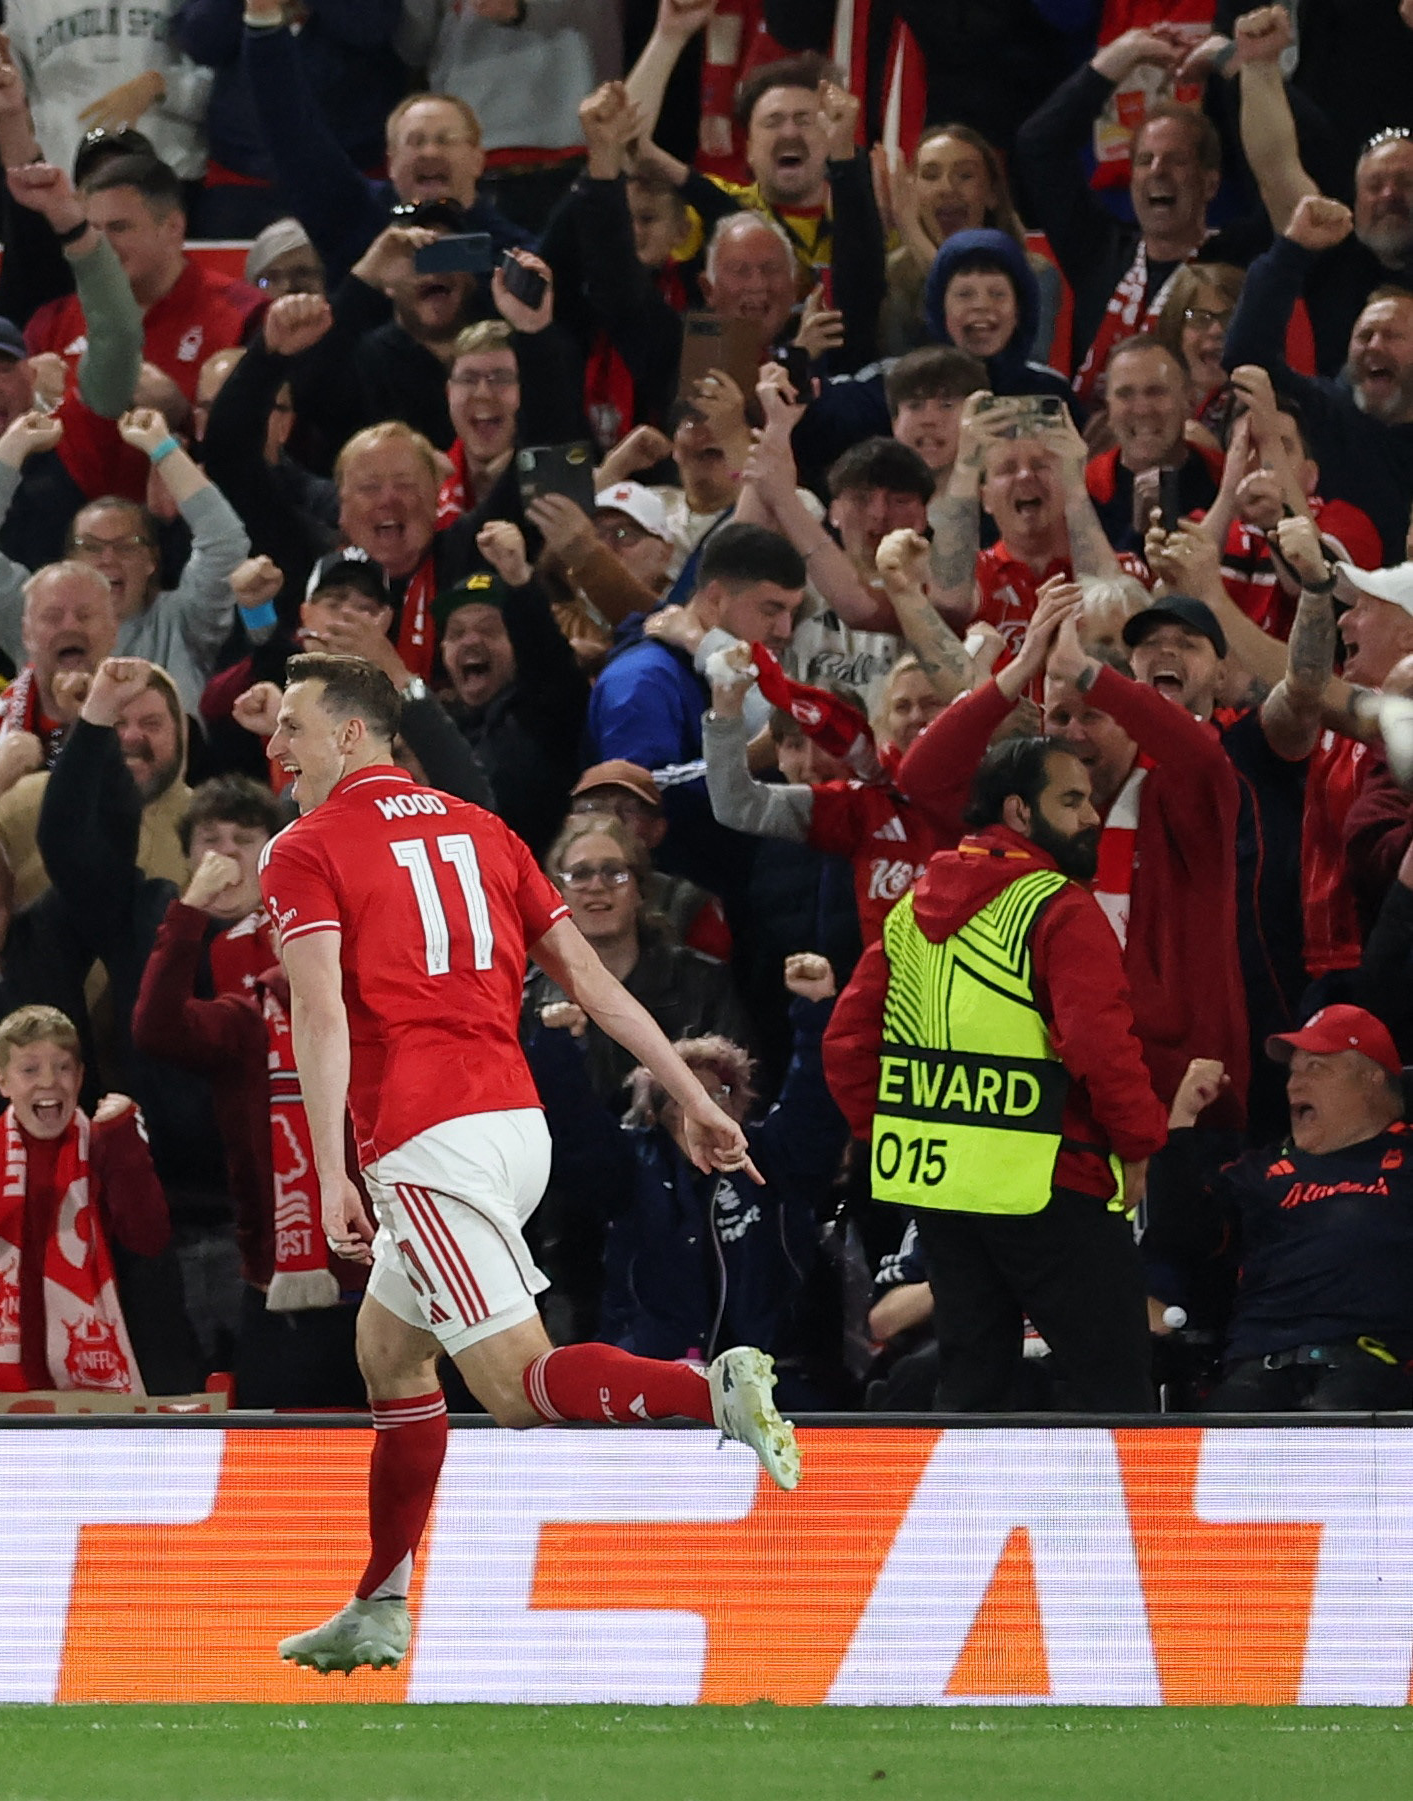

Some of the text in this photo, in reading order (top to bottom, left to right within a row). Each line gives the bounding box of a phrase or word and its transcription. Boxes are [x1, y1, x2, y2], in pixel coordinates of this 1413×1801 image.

[373, 793, 448, 821] WOOD
[389, 833, 494, 976] 11
[879, 1055, 1041, 1117] EWARD
[876, 1131, 948, 1187] 015
